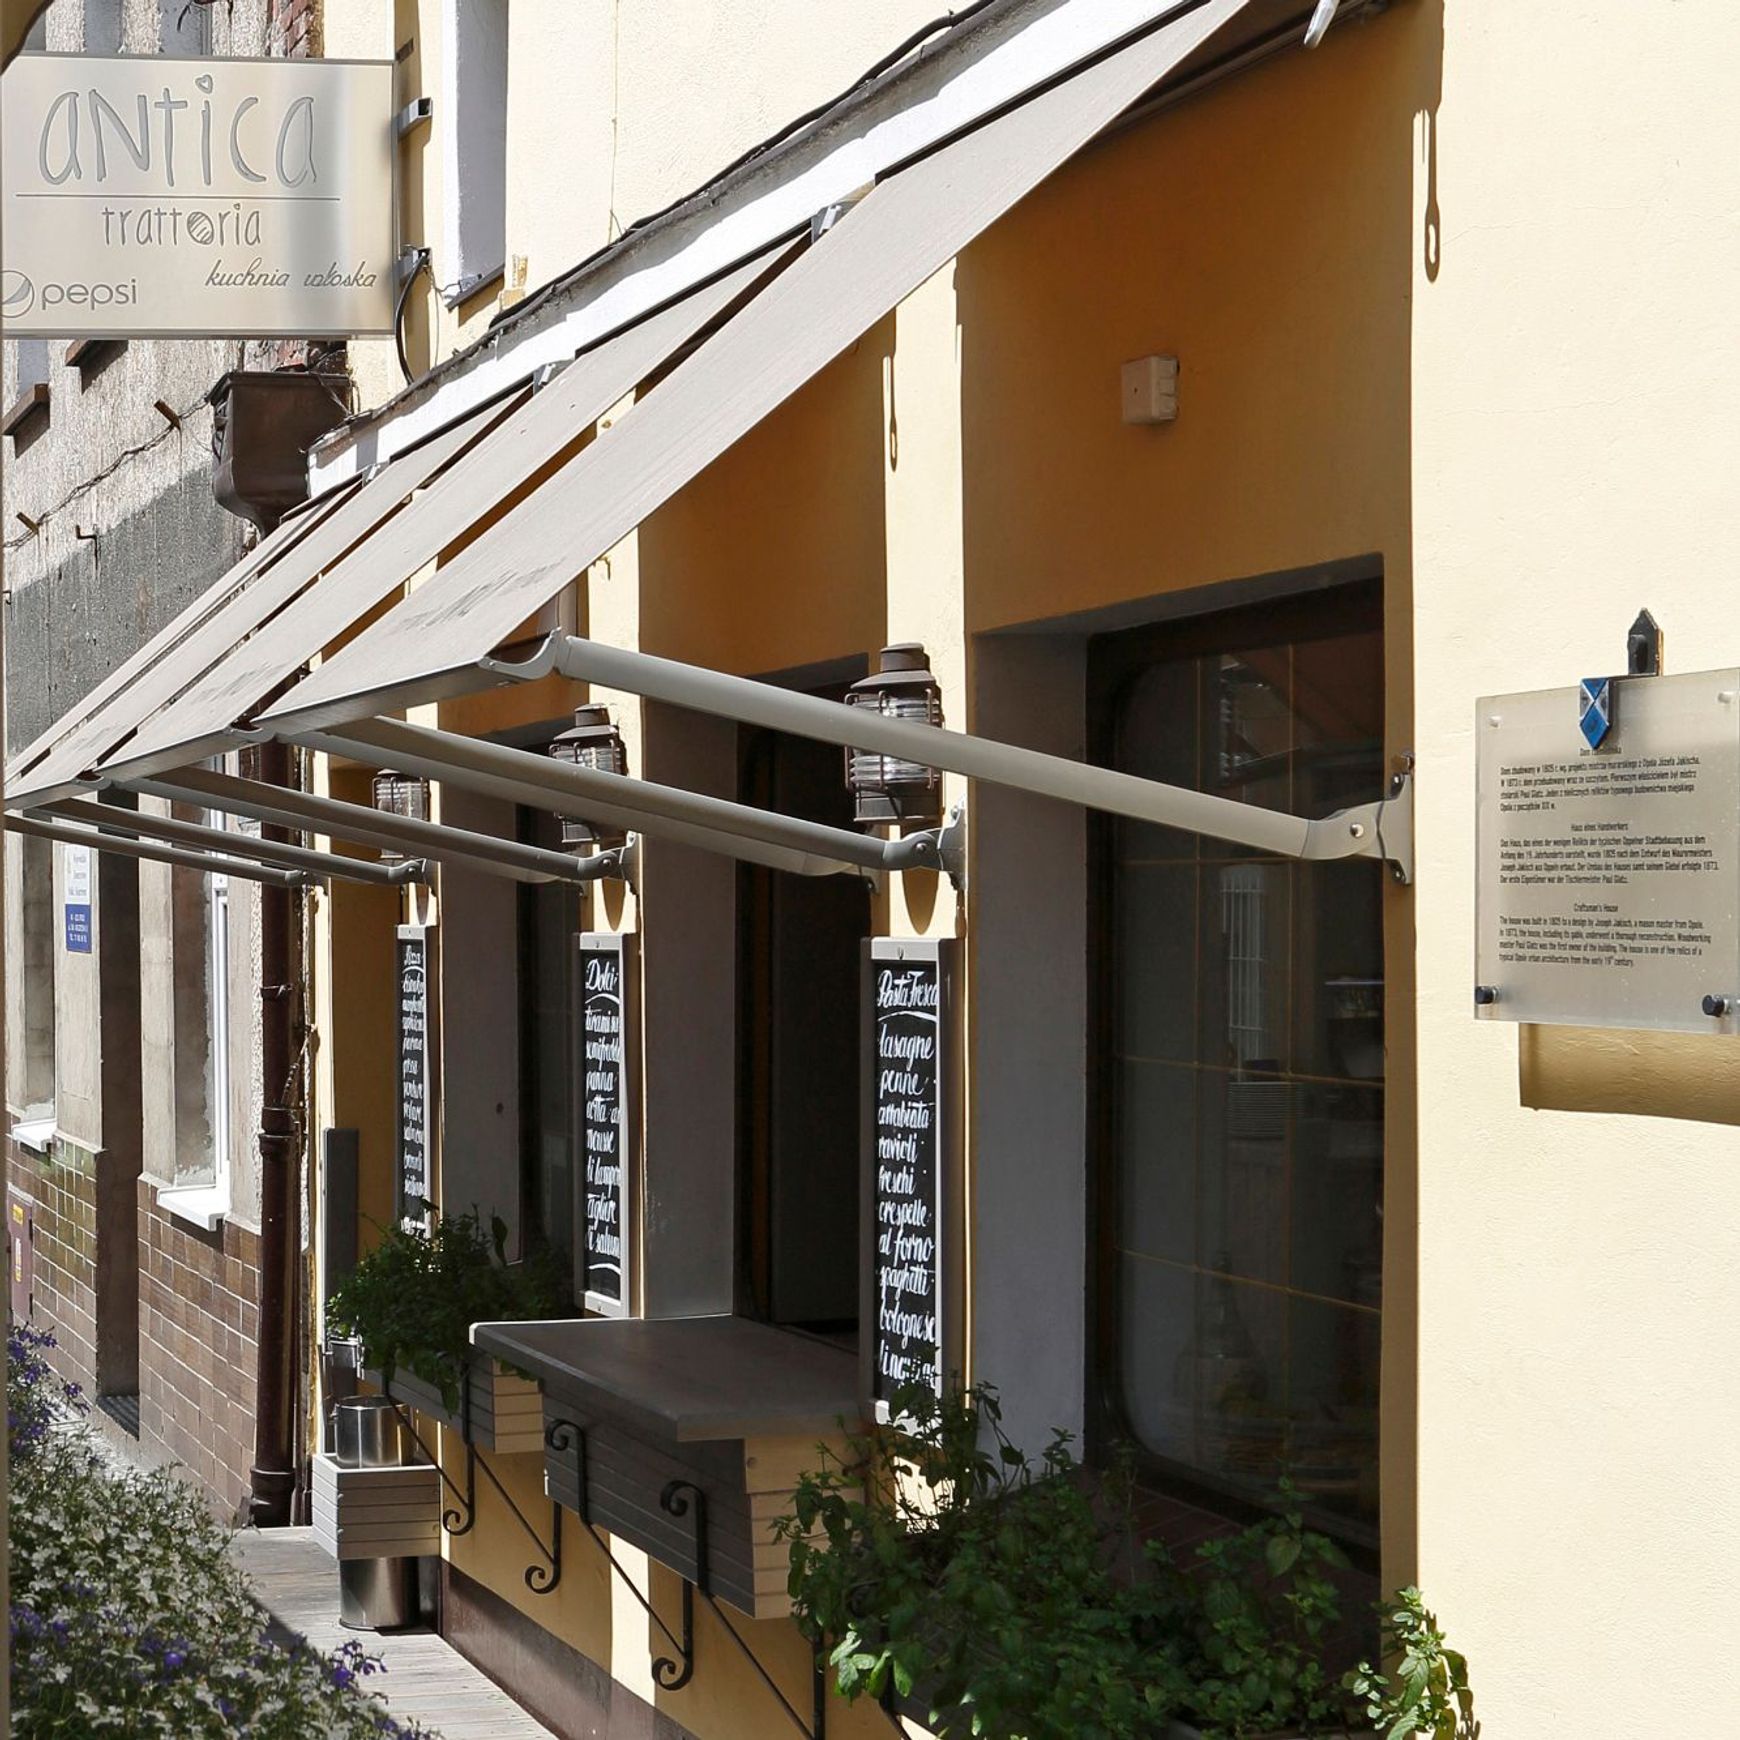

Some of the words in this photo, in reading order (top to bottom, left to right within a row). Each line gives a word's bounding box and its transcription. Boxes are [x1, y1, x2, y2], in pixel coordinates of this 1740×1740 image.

[102, 203, 262, 246] trattoria
[205, 257, 290, 288] kuchnia
[303, 261, 377, 289] włoska
[41, 278, 138, 310] pepsi
[585, 958, 616, 991] Dolci
[877, 970, 908, 1008] Pasta
[878, 1023, 934, 1071] lasagne
[880, 1069, 924, 1099] penne
[878, 1134, 917, 1163] ravioli
[879, 1228, 893, 1255] al
[893, 1230, 934, 1267] forno
